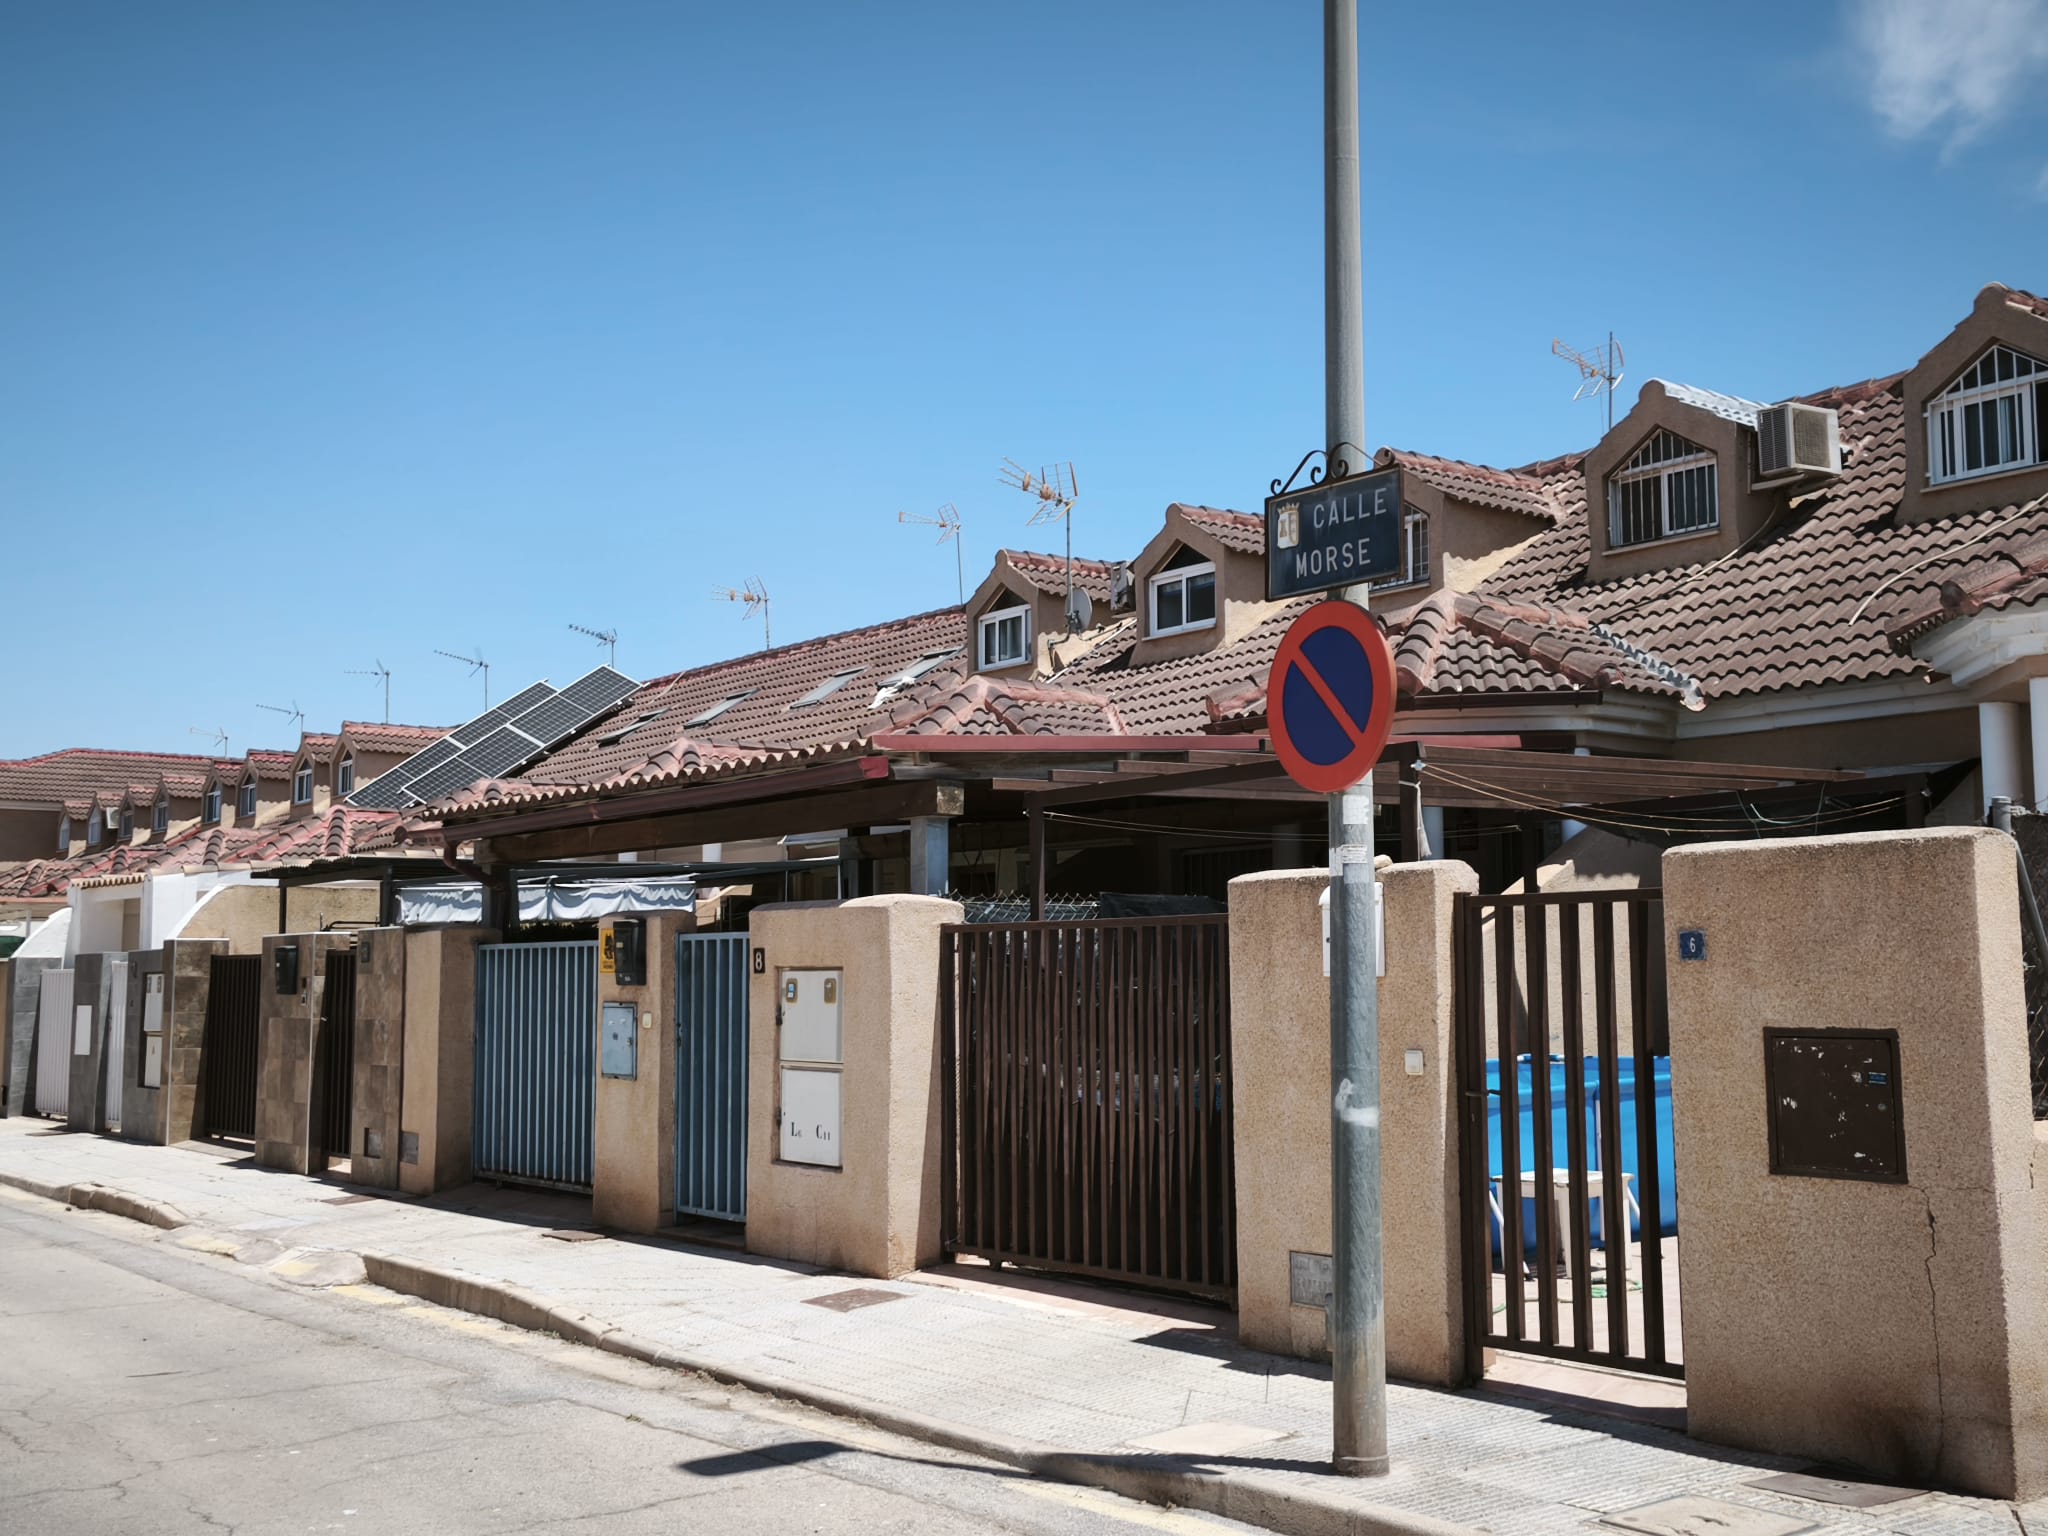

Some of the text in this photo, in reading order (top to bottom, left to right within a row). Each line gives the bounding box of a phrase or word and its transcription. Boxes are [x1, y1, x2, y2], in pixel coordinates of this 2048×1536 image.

[1313, 487, 1387, 529] CALLE
[1295, 537, 1371, 579] MORSE
[1690, 936, 1696, 953] 6
[755, 951, 763, 971] 8
